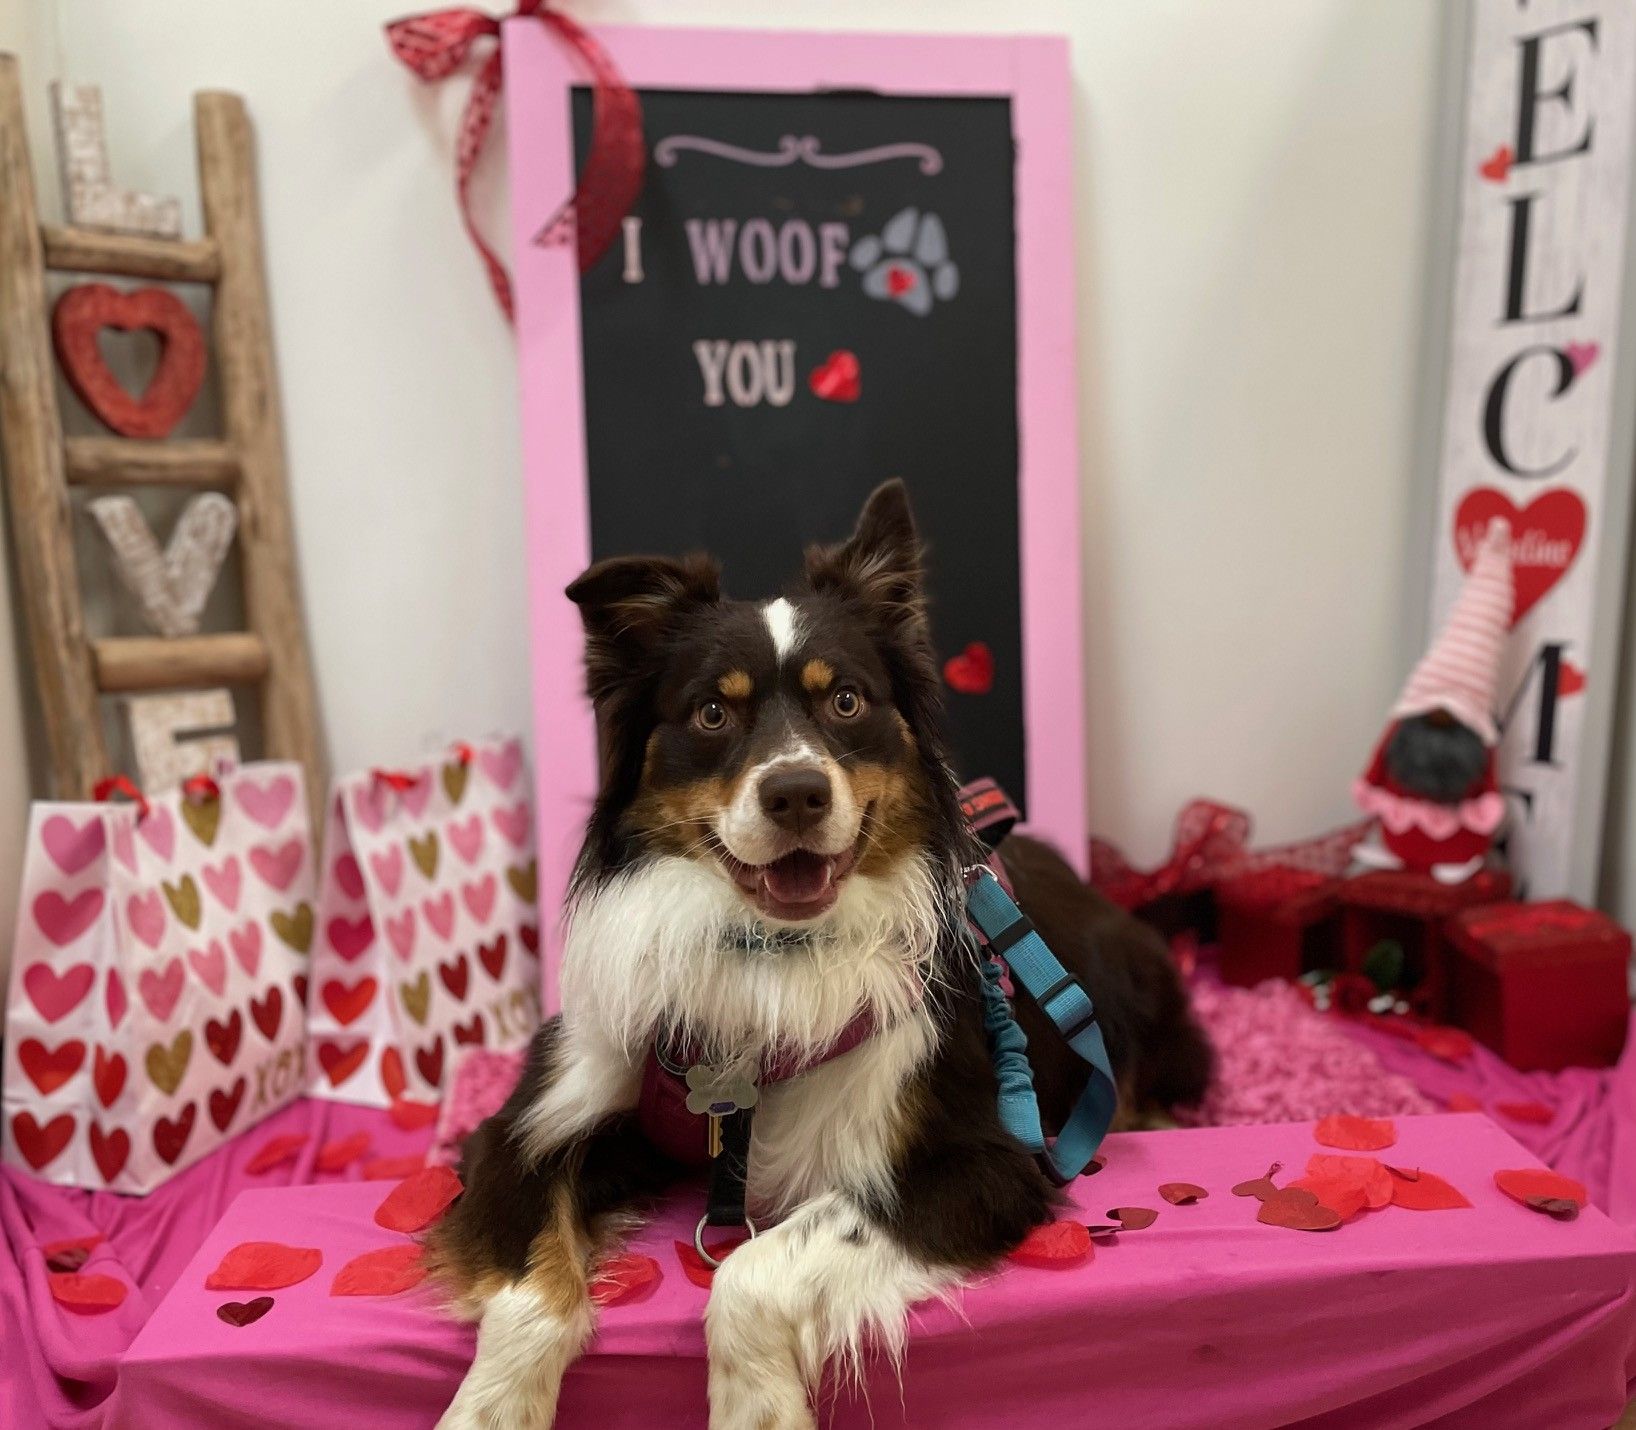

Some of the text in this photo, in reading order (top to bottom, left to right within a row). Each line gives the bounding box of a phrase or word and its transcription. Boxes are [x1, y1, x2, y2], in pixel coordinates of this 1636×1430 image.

[622, 216, 849, 289] I WOOF
[693, 339, 797, 407] YOU
